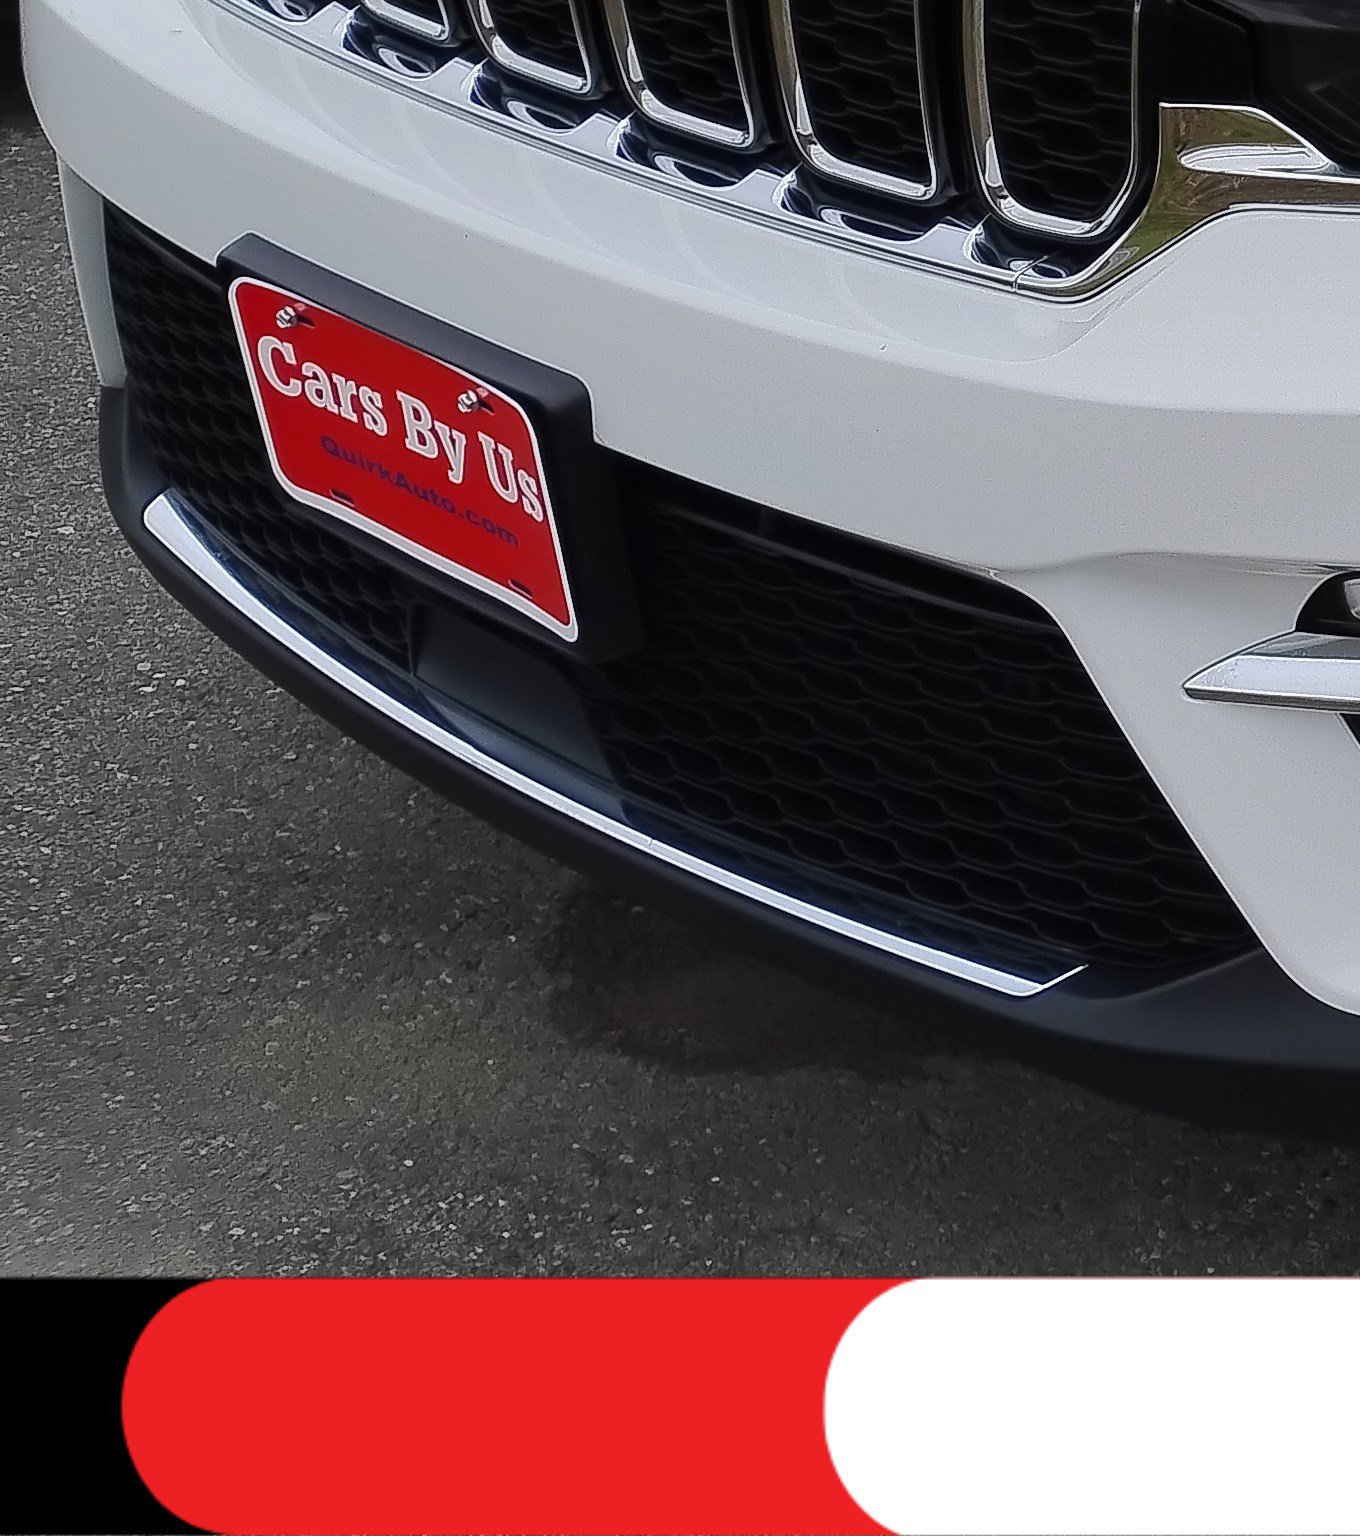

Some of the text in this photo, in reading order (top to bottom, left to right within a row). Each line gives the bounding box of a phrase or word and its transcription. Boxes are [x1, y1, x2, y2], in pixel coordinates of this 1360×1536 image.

[257, 335, 545, 523] Cars By Us
[320, 434, 520, 548] QuirkAuto.com
